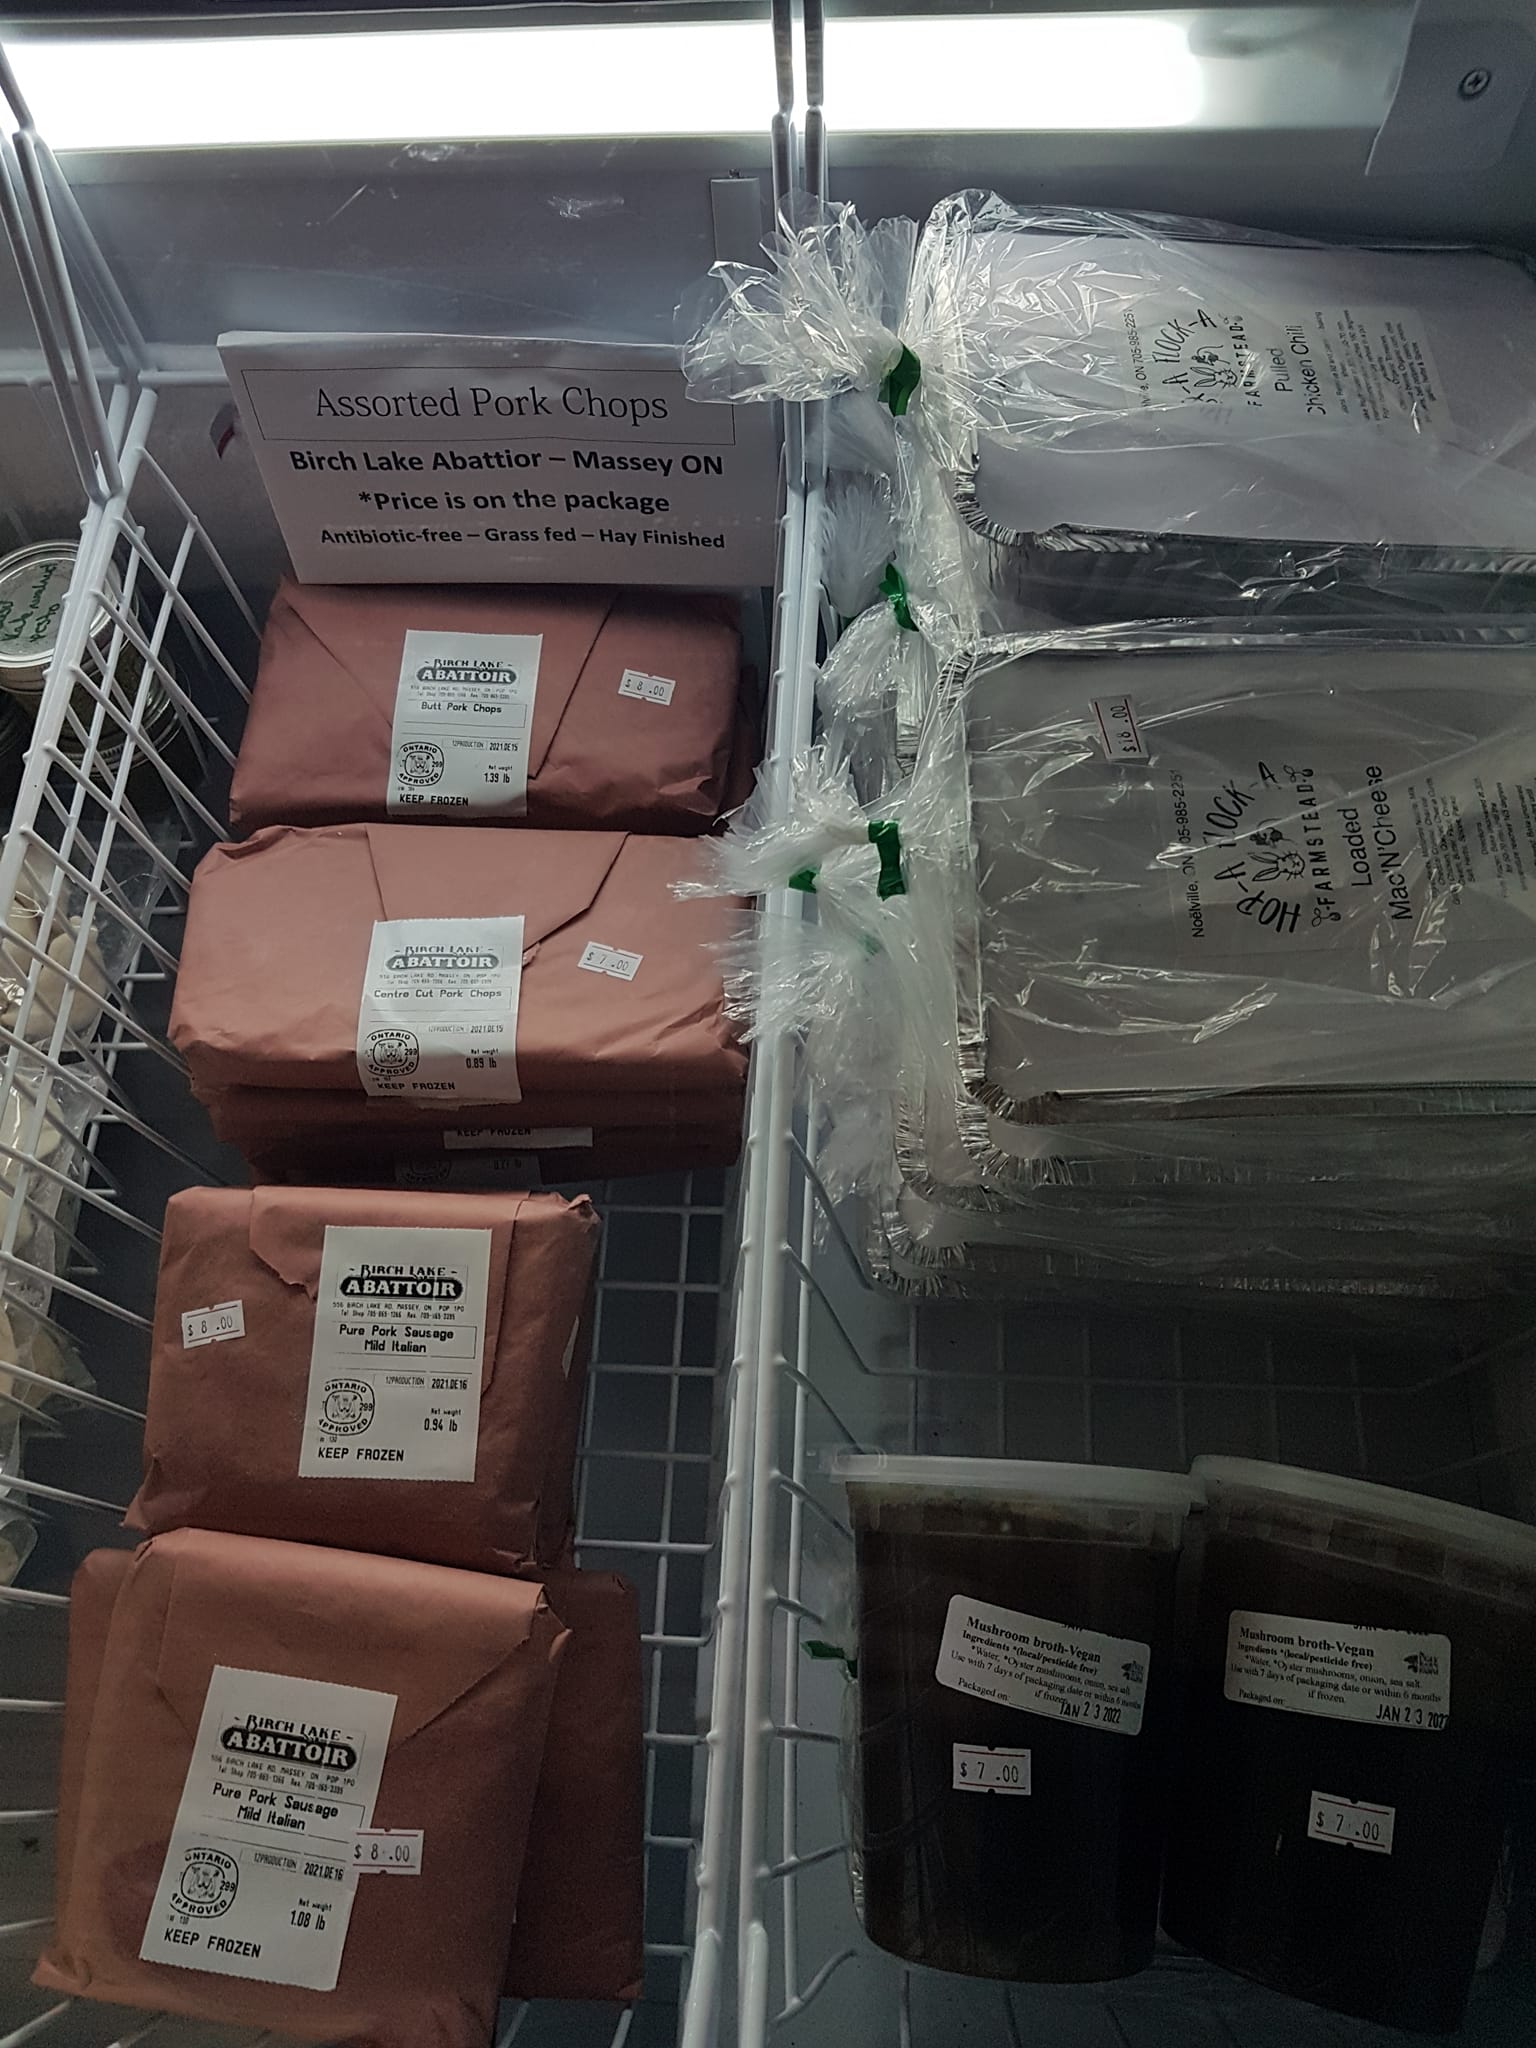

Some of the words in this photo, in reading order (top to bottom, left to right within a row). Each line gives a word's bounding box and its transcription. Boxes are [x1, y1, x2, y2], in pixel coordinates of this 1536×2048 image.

[1286, 325, 1309, 354] Chili
[1136, 366, 1148, 381] ON
[1269, 347, 1293, 392] Pulled
[316, 387, 460, 417] Assorted
[471, 387, 549, 416] Pork
[561, 387, 668, 426] Chops
[290, 451, 356, 471] Birch
[365, 452, 423, 471] Lake
[432, 451, 541, 470] Abattior
[573, 451, 673, 477] Massey
[682, 455, 723, 475] ON
[445, 491, 465, 510] is
[473, 493, 505, 509] on
[513, 490, 556, 508] the
[565, 491, 669, 515] package
[321, 527, 462, 544] Antibiotic-free
[485, 528, 539, 543] Grass
[544, 527, 576, 542] fed
[599, 529, 637, 547] Hay
[643, 532, 725, 548] Finished
[435, 659, 468, 669] BIRCH
[422, 670, 511, 682] ABATTOIR
[421, 702, 441, 710] Butt
[447, 703, 467, 711] Pork
[474, 704, 502, 714] Chops
[403, 745, 437, 753] ONTARIO
[399, 773, 439, 784] APPROVED
[485, 773, 499, 783] 1.39
[503, 773, 510, 783] lb
[400, 794, 424, 803] KEEP
[431, 796, 468, 806] FROZEN
[1173, 770, 1191, 843] 05-985-2251
[1301, 778, 1332, 908] FARMSTEAD
[1338, 808, 1371, 887] Loaded
[1183, 880, 1204, 937] Noëlville,
[405, 946, 444, 956] BIRCH
[392, 957, 493, 968] ABATTOIR
[416, 989, 433, 998] Cut
[471, 990, 501, 999] Chops
[371, 1032, 410, 1041] ONTARIO
[369, 1062, 414, 1074] APPROVED
[489, 1058, 496, 1068] lb
[361, 1265, 403, 1278] BIRCH
[410, 1266, 446, 1277] LAKE
[346, 1280, 456, 1296] ABATTOIR
[340, 1324, 365, 1335] Pure
[372, 1325, 397, 1336] Pork
[405, 1326, 454, 1341] Sausage
[365, 1340, 385, 1351] Mild
[392, 1341, 426, 1352] Italian
[324, 1382, 366, 1394] ONTARIO
[359, 1403, 373, 1411] 299
[319, 1418, 368, 1432] APPROVED
[424, 1418, 443, 1431] 0.94
[449, 1419, 457, 1431] lb
[318, 1447, 349, 1459] KEEP
[357, 1449, 404, 1461] FROZEN
[963, 1630, 1009, 1651] Ingredients
[967, 1616, 1030, 1645] Mushroom
[1033, 1636, 1100, 1662] broth-Vegan
[1240, 1627, 1294, 1645] Mushroom
[1298, 1635, 1374, 1657] broth-Vegan
[951, 1650, 965, 1662] Use
[968, 1658, 985, 1669] with
[994, 1666, 1012, 1677] days
[1237, 1642, 1277, 1655] Ingredients
[1352, 1660, 1372, 1671] free)
[959, 1678, 996, 1696] Packaged
[1261, 1669, 1264, 1677] 7
[1286, 1674, 1295, 1682] of
[1297, 1677, 1339, 1691] packaging
[1341, 1682, 1359, 1692] date
[1362, 1687, 1371, 1695] or
[1375, 1688, 1401, 1698] within
[1240, 1689, 1271, 1703] Packaged
[1308, 1690, 1315, 1698] if
[1317, 1690, 1344, 1703] frozen
[1060, 1703, 1080, 1717] JAN
[1103, 1706, 1121, 1724] 2022
[1376, 1704, 1400, 1722] JAN
[246, 1715, 294, 1732] BIRCH
[300, 1724, 341, 1741] LAKE
[227, 1731, 348, 1766] ABATTOIR
[213, 1782, 241, 1799] Pure
[248, 1789, 276, 1806] Pork
[284, 1796, 338, 1818] Sausage
[237, 1805, 261, 1822] Mild
[267, 1811, 305, 1830] Italian
[184, 1852, 232, 1869] ONTARIO
[220, 1880, 235, 1892] 299
[172, 1893, 227, 1914] APPROVED
[290, 1910, 312, 1928] 1.08
[315, 1914, 325, 1930] lb
[164, 1928, 200, 1945] KEEP
[207, 1936, 262, 1958] FROZEN
